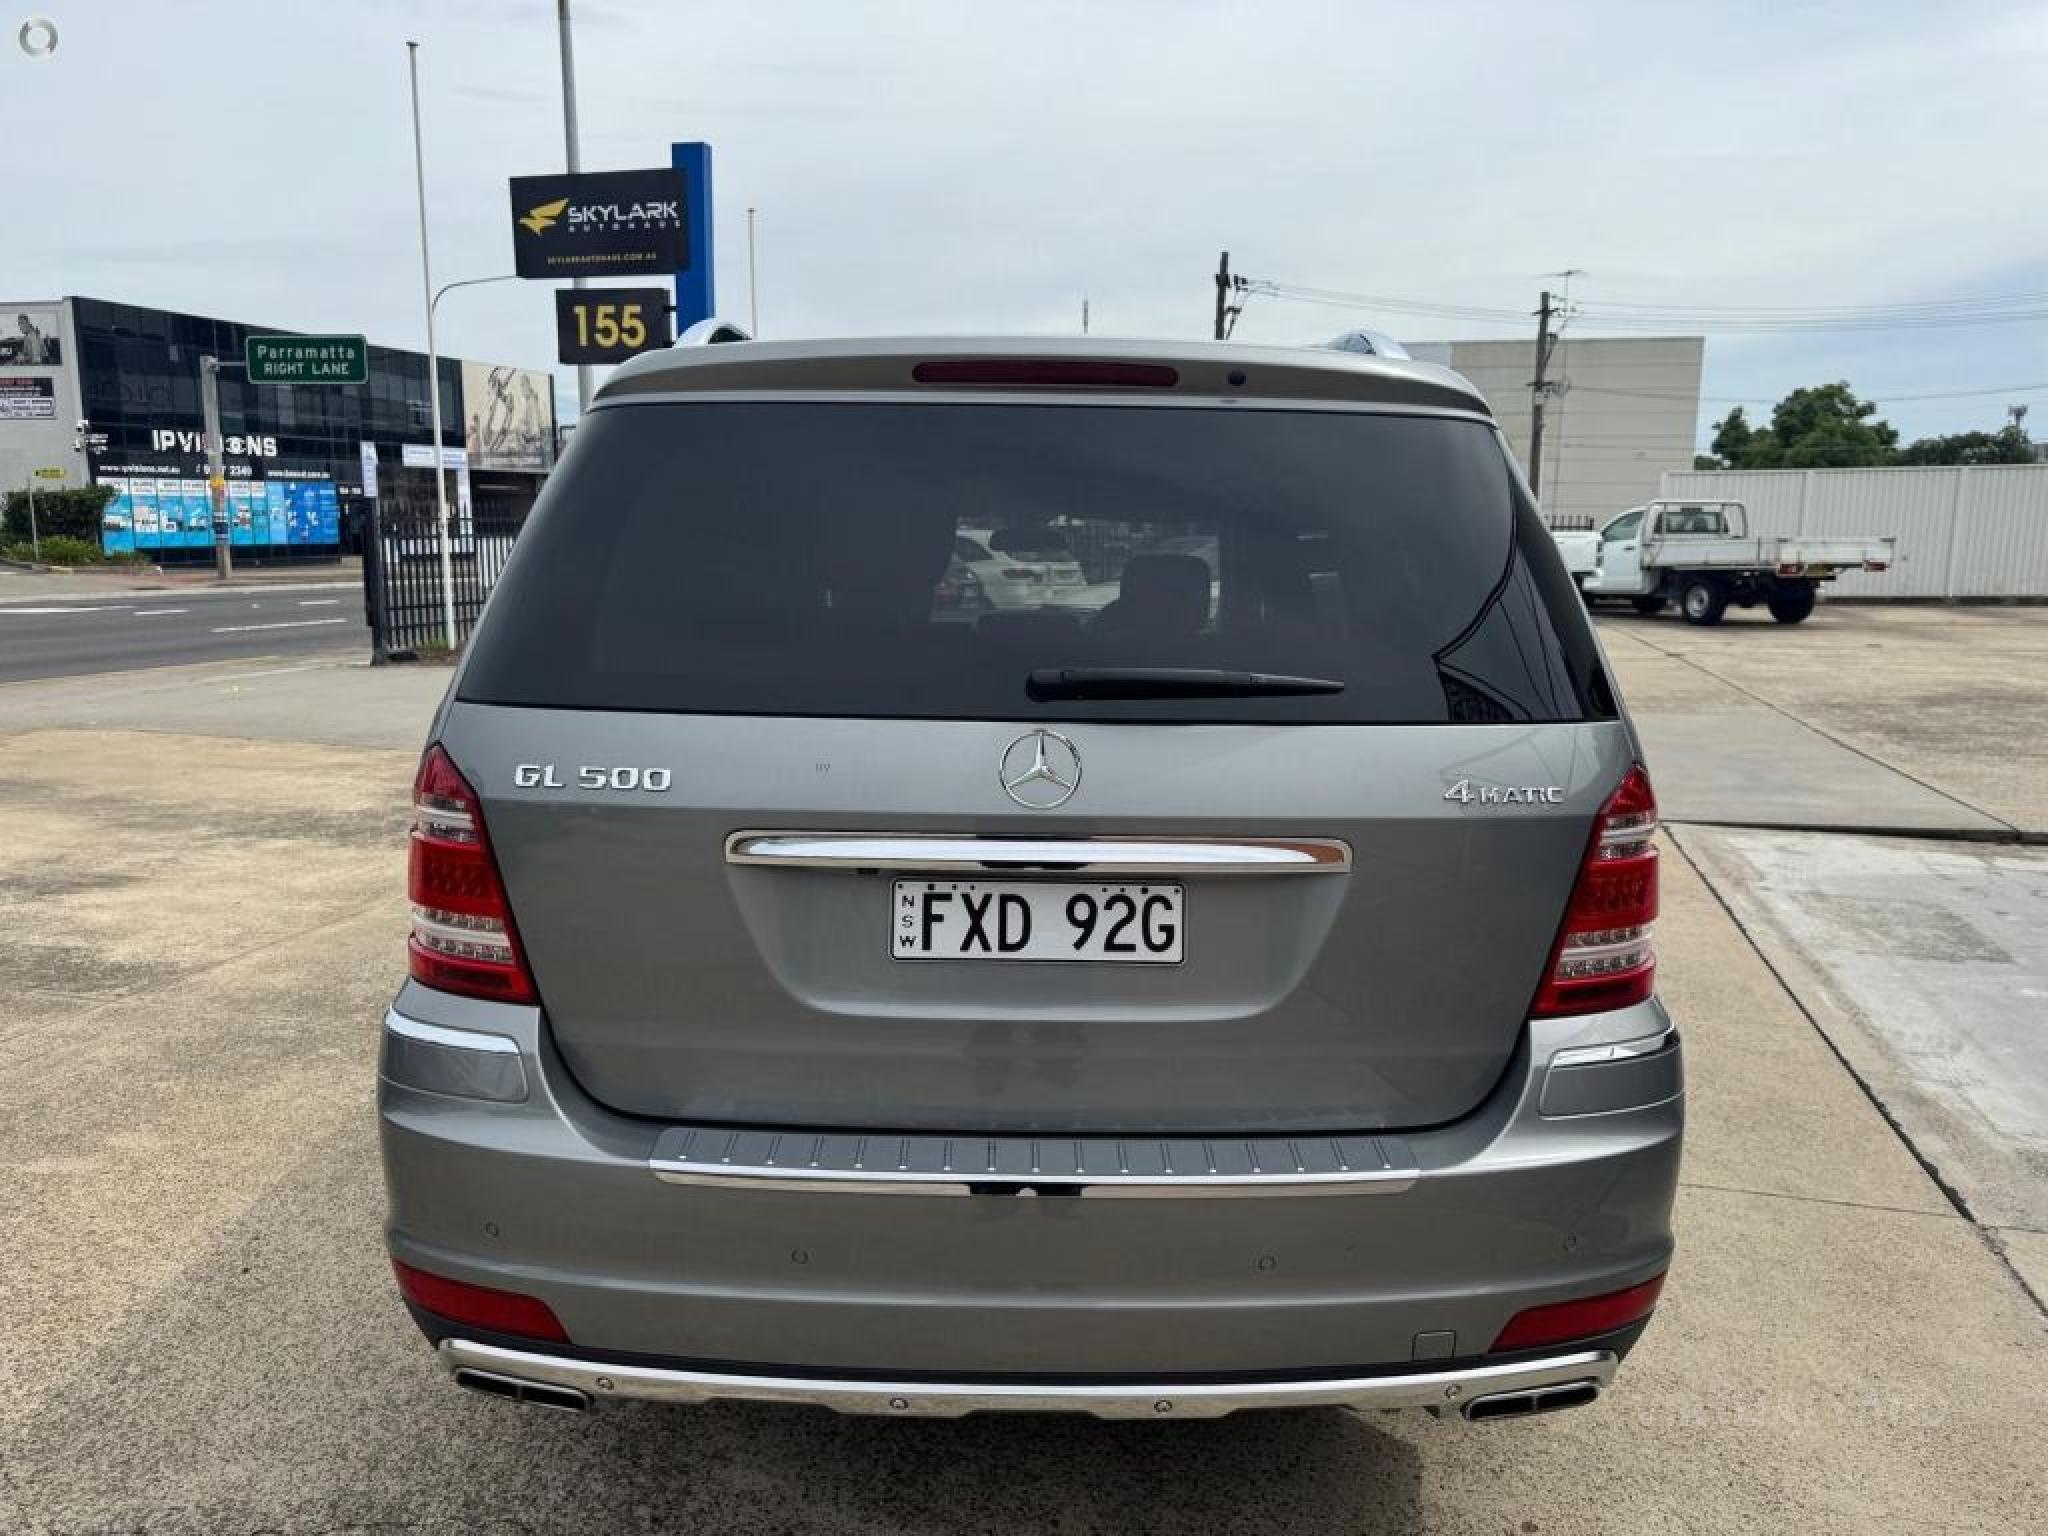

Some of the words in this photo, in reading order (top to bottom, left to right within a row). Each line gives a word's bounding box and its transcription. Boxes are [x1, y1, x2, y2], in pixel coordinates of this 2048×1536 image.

[568, 201, 679, 223] SKYLARK
[573, 303, 648, 349] 155
[257, 344, 355, 360] Parramatta
[263, 361, 305, 375] RIGHT
[311, 361, 352, 375] LANE
[514, 764, 567, 788] GL
[578, 765, 673, 792] 500
[921, 893, 1033, 953] FXD
[1065, 893, 1177, 953] 92G
